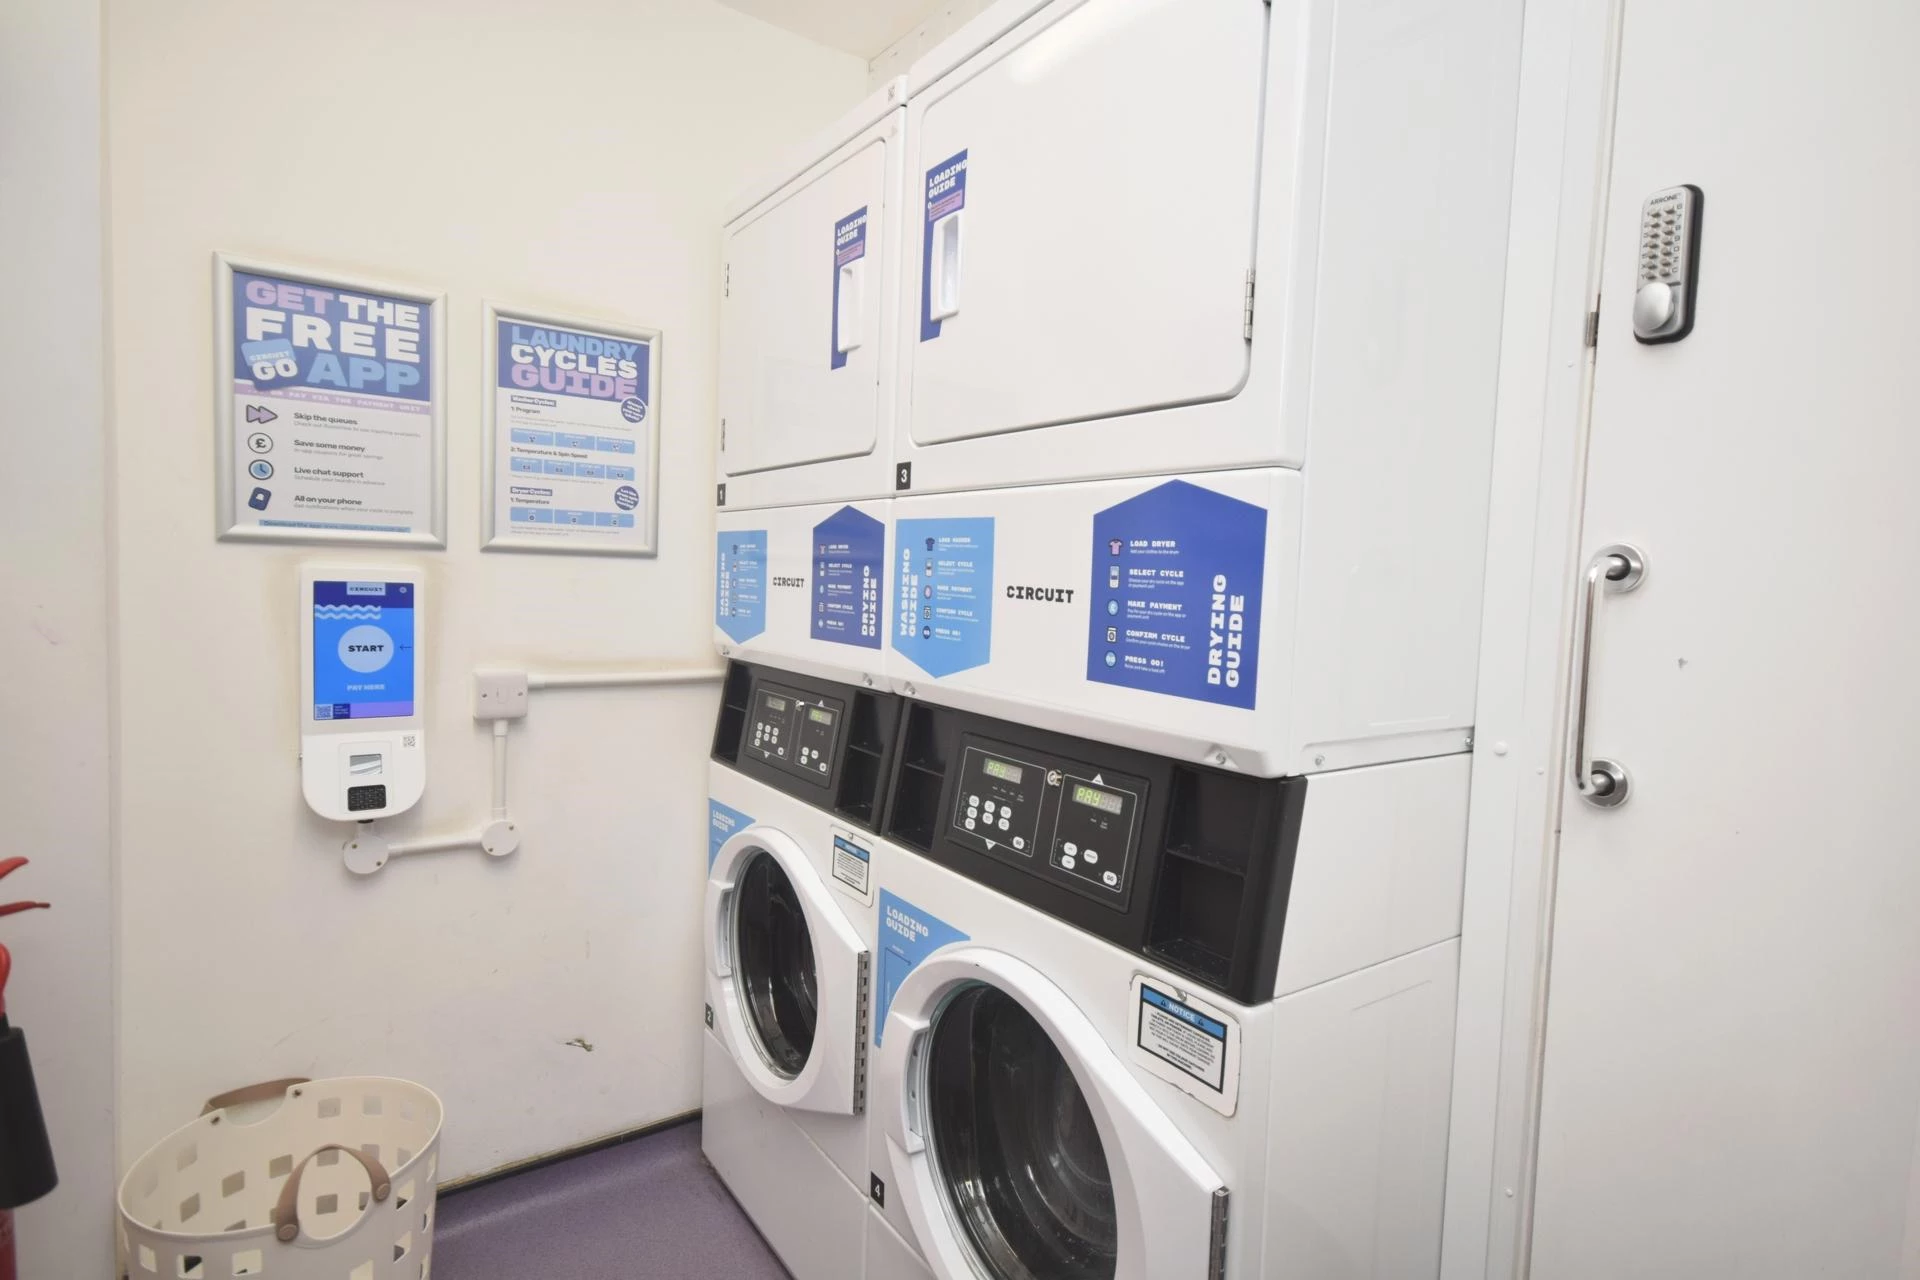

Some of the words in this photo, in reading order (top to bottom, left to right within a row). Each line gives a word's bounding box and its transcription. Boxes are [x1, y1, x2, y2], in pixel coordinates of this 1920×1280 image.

[930, 160, 967, 187] LOADING
[928, 177, 956, 199] GUIDE
[1651, 194, 1678, 205] ARRONE
[838, 214, 867, 237] LOADING
[837, 229, 858, 246] GUIDE
[246, 281, 334, 314] GET
[338, 294, 420, 330] THE
[246, 306, 420, 364] FREE
[512, 325, 638, 361] LAUNDRY
[511, 344, 638, 380] CYCLES
[252, 358, 298, 380] GO
[306, 352, 420, 394] APP
[512, 364, 638, 400] GUIDE
[294, 412, 312, 422] Skip
[313, 413, 327, 422] the
[328, 416, 358, 425] queues
[294, 440, 313, 448] Save
[338, 444, 365, 453] money
[517, 448, 552, 456] Temperature
[294, 466, 311, 475] Live
[312, 468, 332, 476] chat
[333, 471, 364, 479] support
[901, 466, 907, 483] 3
[337, 498, 362, 506] phone
[772, 576, 804, 588] CIRCUIT
[900, 548, 910, 636] WASHING
[1006, 586, 1074, 604] CIRCUIT
[908, 574, 918, 638] GUIDE
[1150, 602, 1182, 610] PAYMENT
[1126, 630, 1157, 640] CONFIRM
[1162, 633, 1185, 642] CYCLE
[1207, 574, 1227, 686] DRYING
[348, 644, 384, 653] START
[1226, 595, 1244, 688] GUIDE
[1125, 656, 1146, 664] PRESS
[1151, 659, 1164, 667] GO!
[1077, 787, 1100, 806] PAY
[886, 904, 929, 937] LOADING
[886, 917, 916, 942] GUIDE
[1168, 1002, 1196, 1020] NOTICE
[875, 1185, 880, 1197] 4
